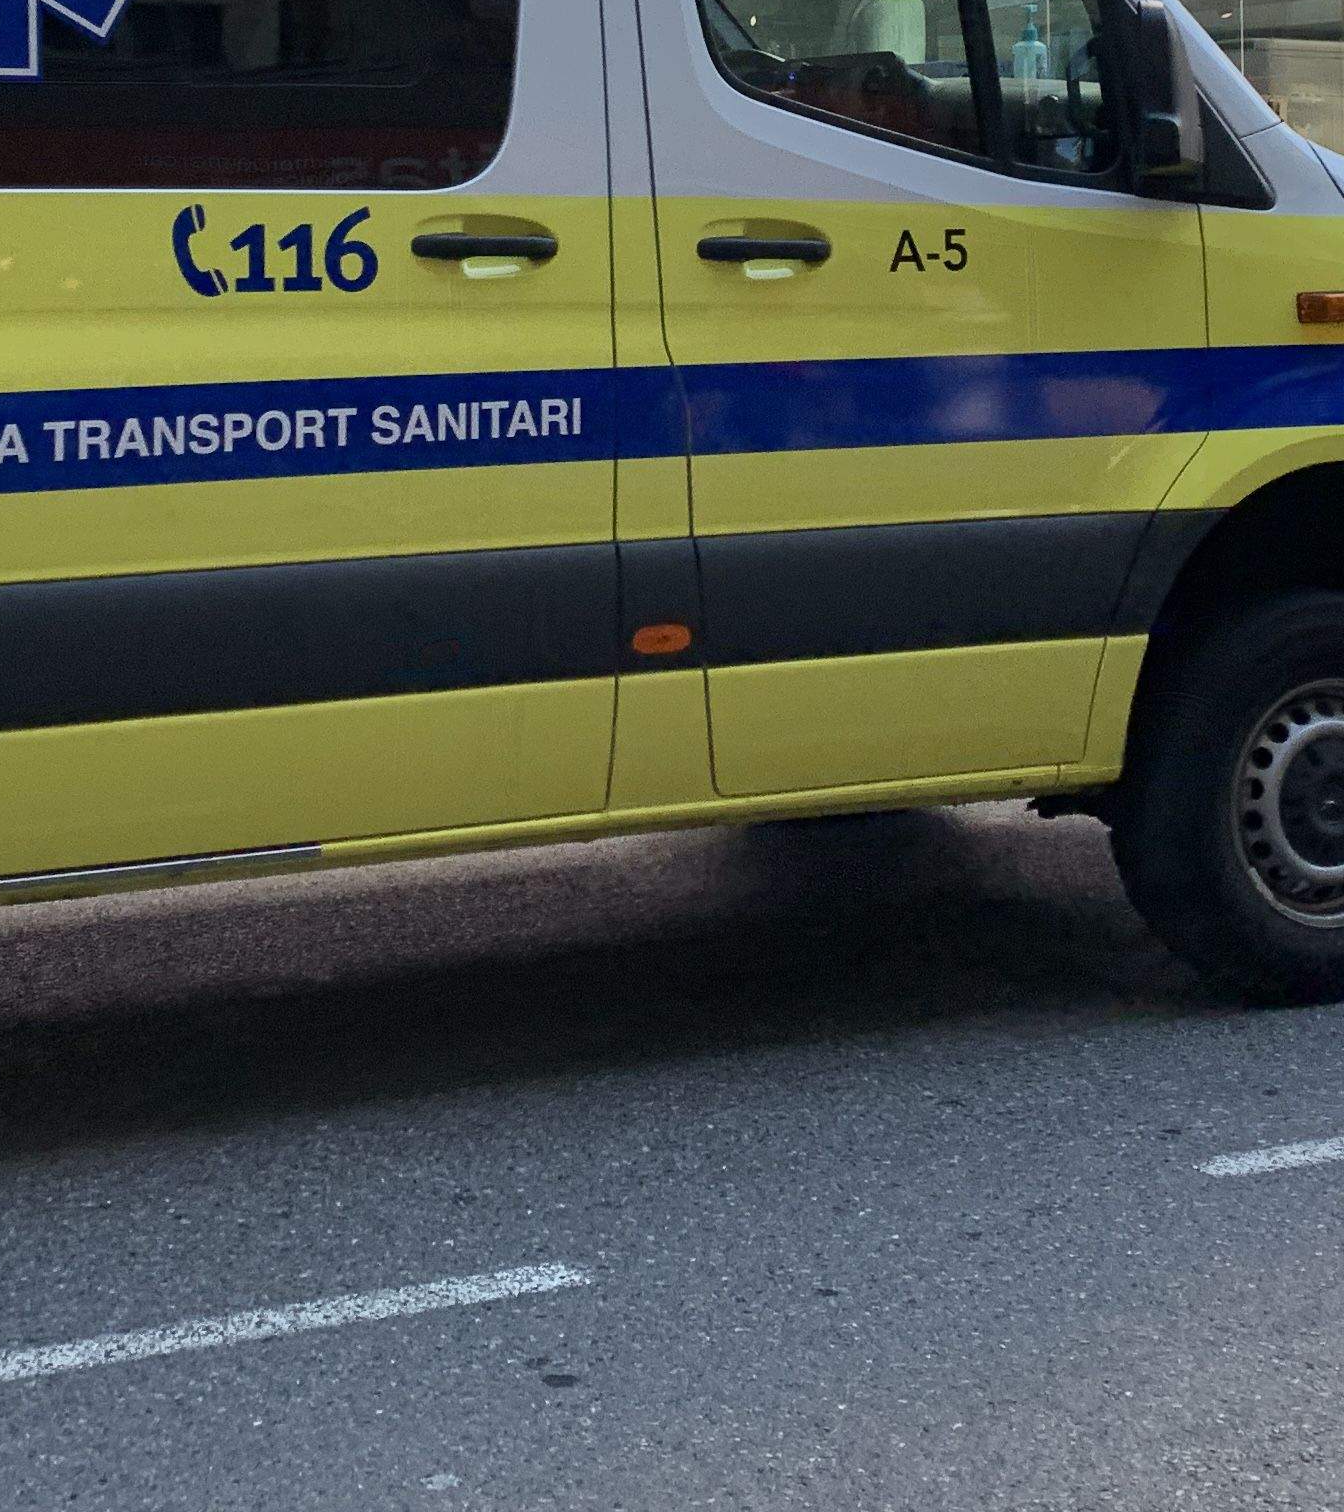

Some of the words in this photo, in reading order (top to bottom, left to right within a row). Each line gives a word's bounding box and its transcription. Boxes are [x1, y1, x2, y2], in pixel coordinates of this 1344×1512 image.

[229, 206, 379, 293] 116
[889, 228, 968, 273] A-5
[42, 407, 358, 462] TRANSPORT
[371, 397, 582, 445] SANITARI
